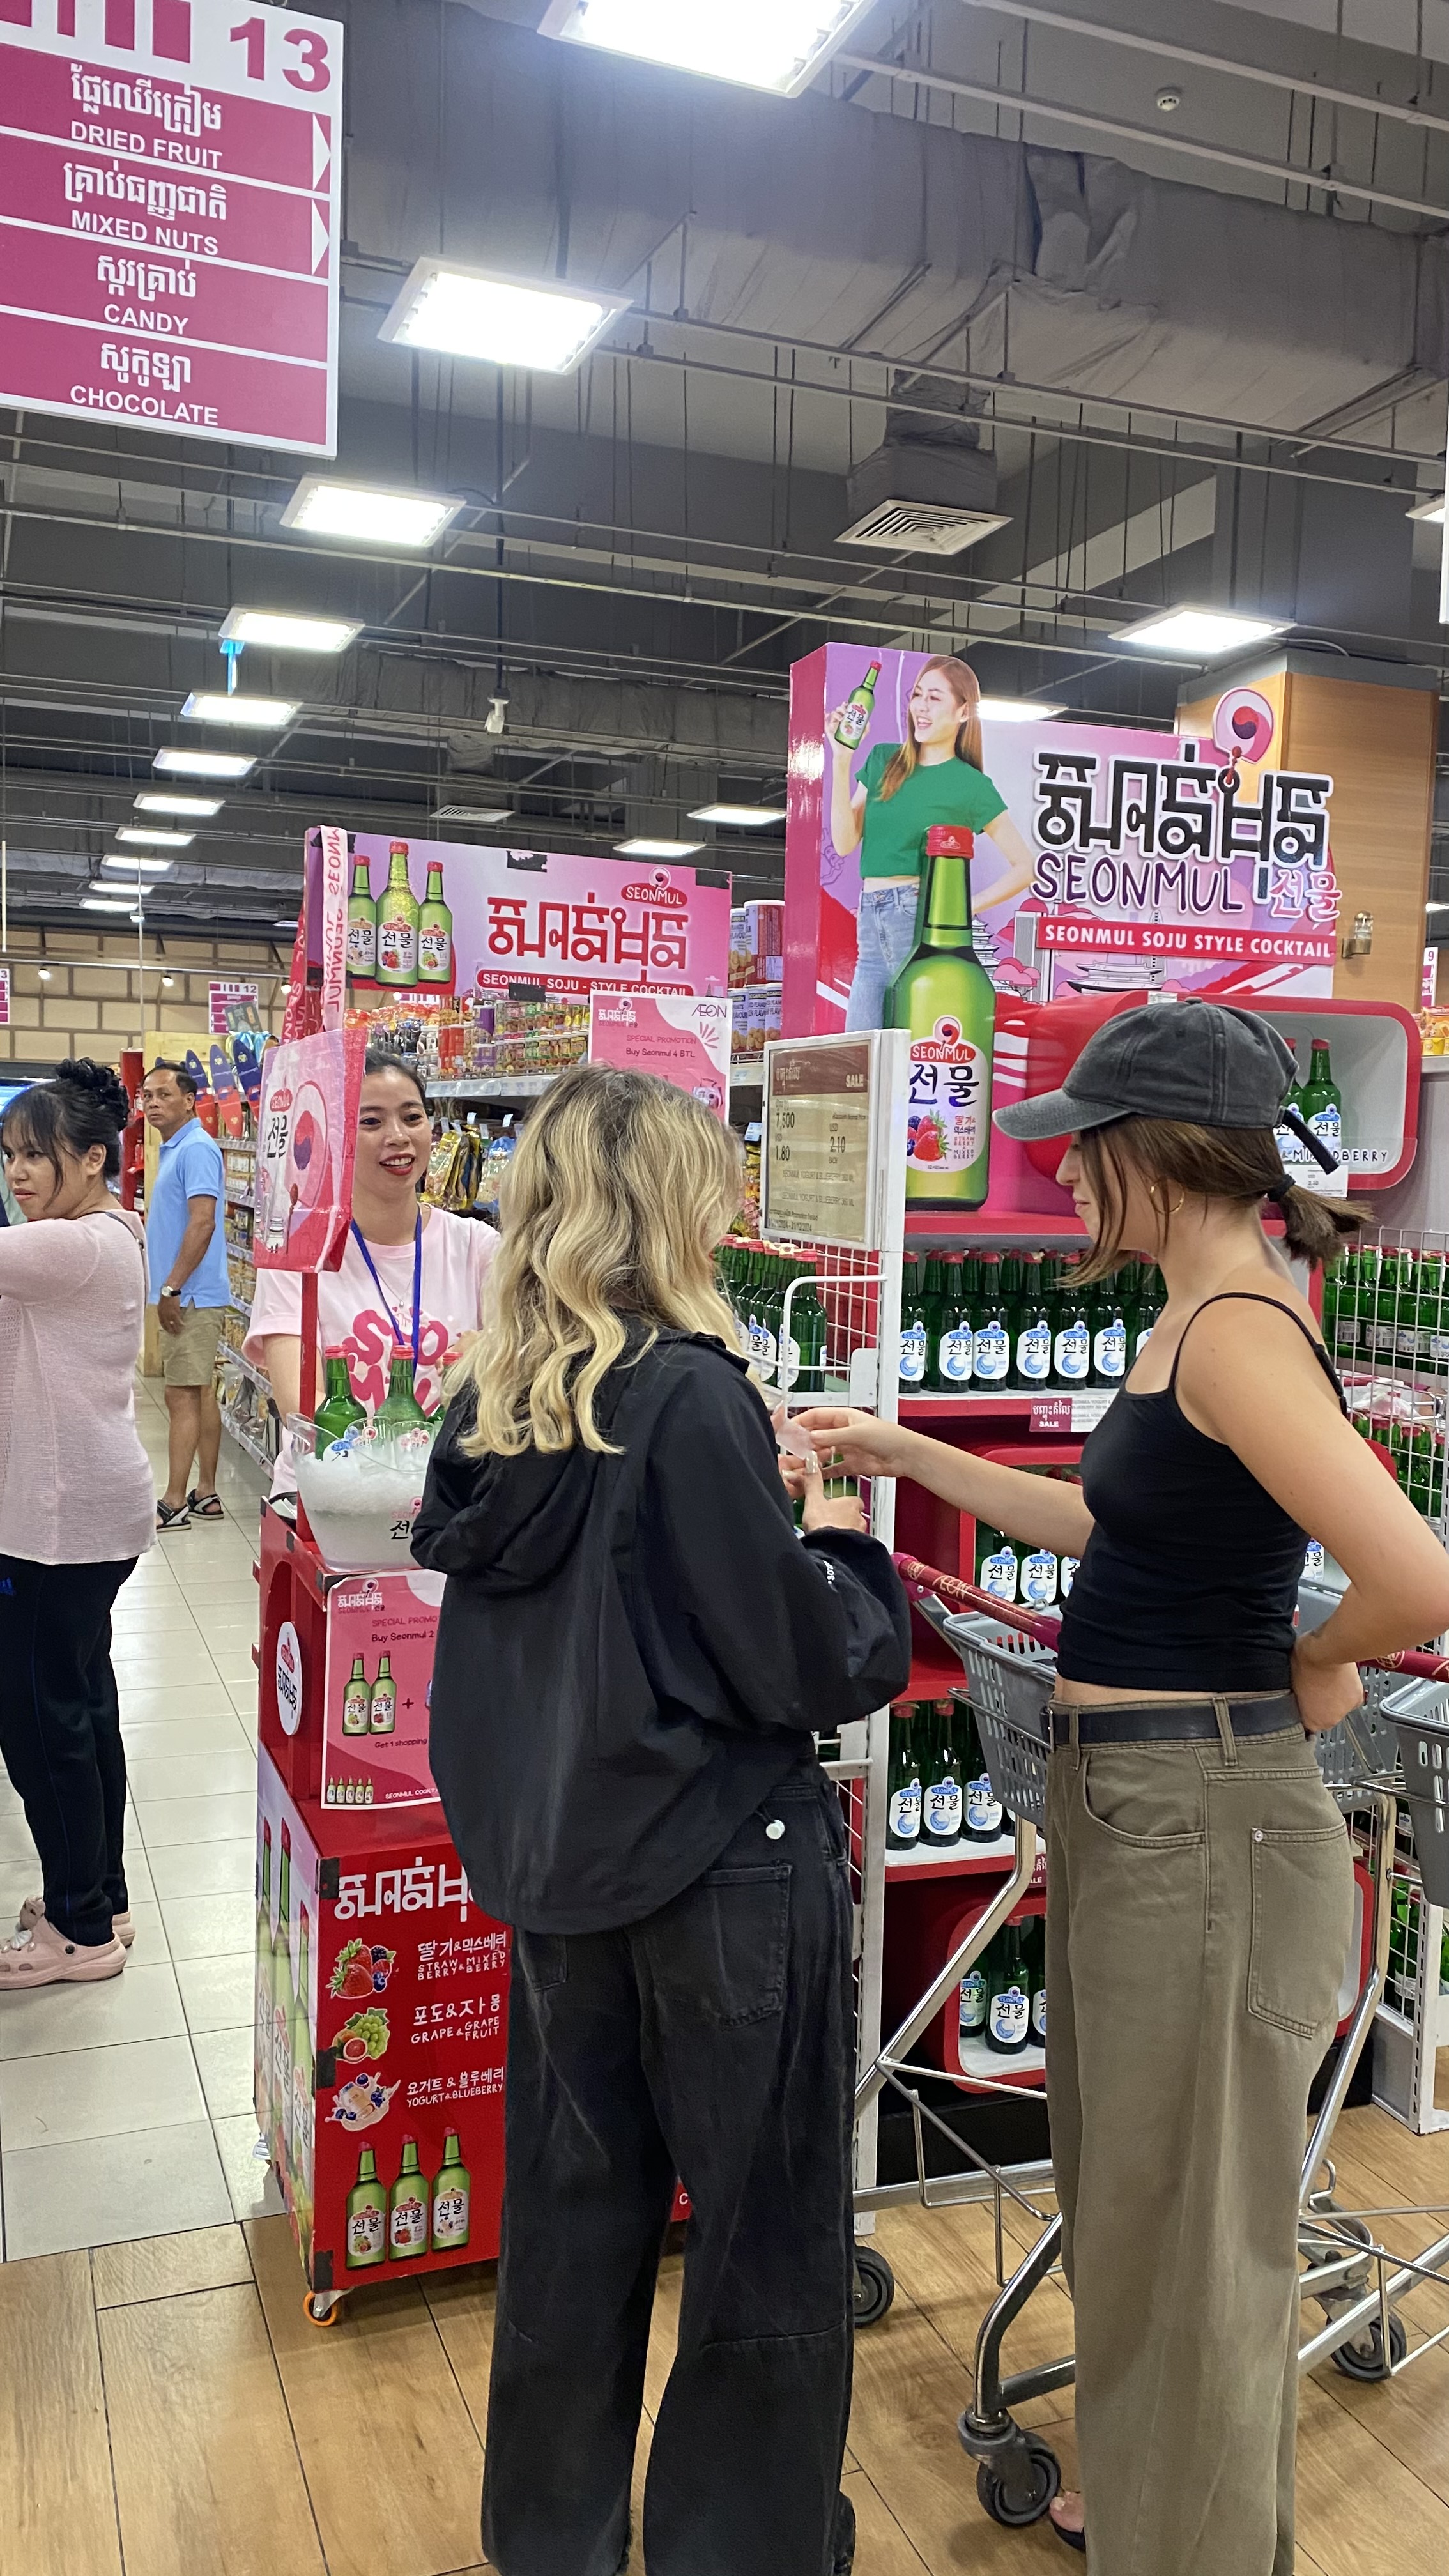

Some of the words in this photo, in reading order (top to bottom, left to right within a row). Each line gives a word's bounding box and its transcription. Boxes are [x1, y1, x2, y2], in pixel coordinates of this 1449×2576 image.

[229, 17, 331, 93] 13
[71, 120, 146, 154] DRIED
[153, 138, 222, 169] FRUIT
[72, 210, 148, 241] MIXED
[155, 225, 218, 255] NUTS
[103, 304, 188, 335] CANDY
[70, 385, 218, 426] CHOCOLATE
[1032, 853, 1243, 912] SEONMUL
[626, 886, 683, 905] SEONMUL
[1046, 924, 1135, 946] SEONMUL
[1142, 931, 1187, 949] SOJU
[1195, 935, 1243, 953] STYLE
[1250, 938, 1331, 958] COCKTAIL
[547, 978, 579, 991] SOJU
[591, 982, 627, 993] STYLE
[631, 984, 687, 997] COCKTAIL
[626, 1034, 655, 1043] SPECIAL
[657, 1036, 696, 1044] PROMOTION
[626, 1048, 640, 1056] Buy
[642, 1048, 671, 1057] Seonmul
[680, 1050, 695, 1058] BTL
[912, 1045, 972, 1061] SEONMUL
[845, 1074, 864, 1088] SALE
[776, 1112, 795, 1130] 7,500
[776, 1146, 790, 1161] 1.80
[1293, 1150, 1339, 1161] MID
[1342, 1151, 1387, 1162] BERRY
[372, 1618, 406, 1627] SPECIAL
[408, 1615, 440, 1625] PROMO
[372, 1634, 388, 1643] Buy
[390, 1630, 426, 1641] Seonmul
[395, 1738, 427, 1747] shopping
[385, 1791, 413, 1800] SEONMUL
[418, 1959, 458, 1972] STRAW
[466, 1951, 505, 1965] MIXED
[418, 1966, 457, 1981] BERRY
[466, 1959, 505, 1973] BERRY
[411, 2027, 454, 2044] GRAPE
[464, 2016, 500, 2030] GRAPE
[465, 2026, 500, 2041] FRUIT
[406, 2077, 443, 2096] 요거트
